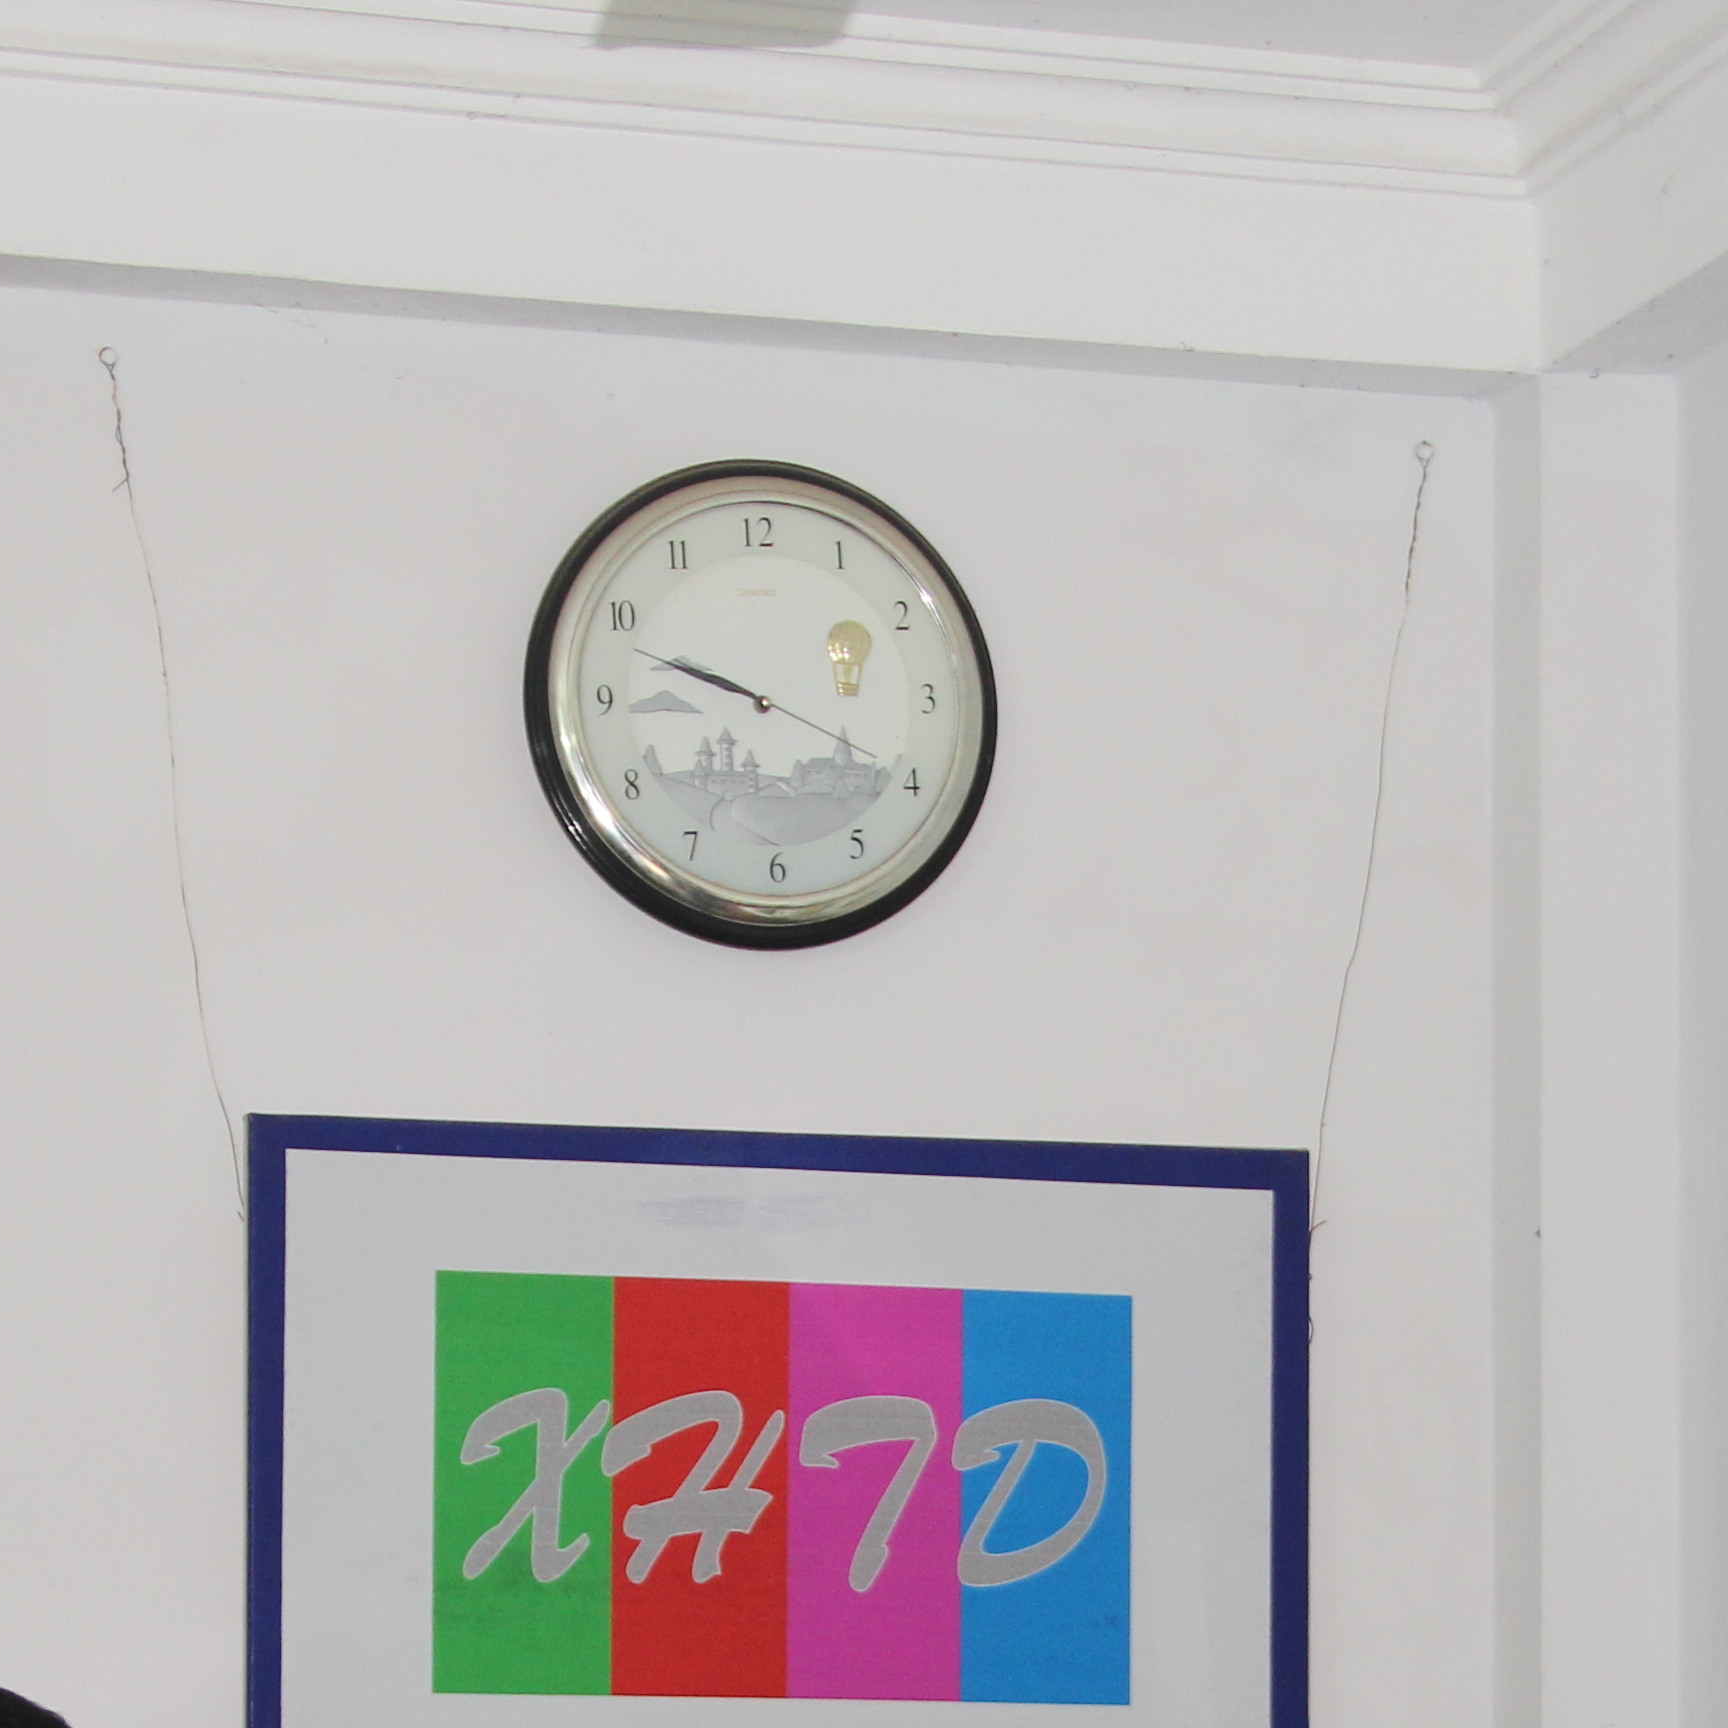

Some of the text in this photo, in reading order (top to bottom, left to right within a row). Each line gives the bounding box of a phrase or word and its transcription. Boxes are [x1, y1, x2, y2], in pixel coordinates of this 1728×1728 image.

[743, 517, 774, 548] 12
[668, 540, 688, 570] 11
[835, 540, 845, 570] 1
[610, 600, 636, 631] 10
[894, 601, 910, 631] 2
[596, 684, 613, 715] 9
[921, 683, 936, 714] 3
[624, 769, 640, 800] 8
[903, 768, 920, 796] 4
[682, 831, 699, 860] 7
[850, 829, 865, 859] 5
[770, 852, 786, 882] 6
[459, 1386, 1109, 1593] XHTD
